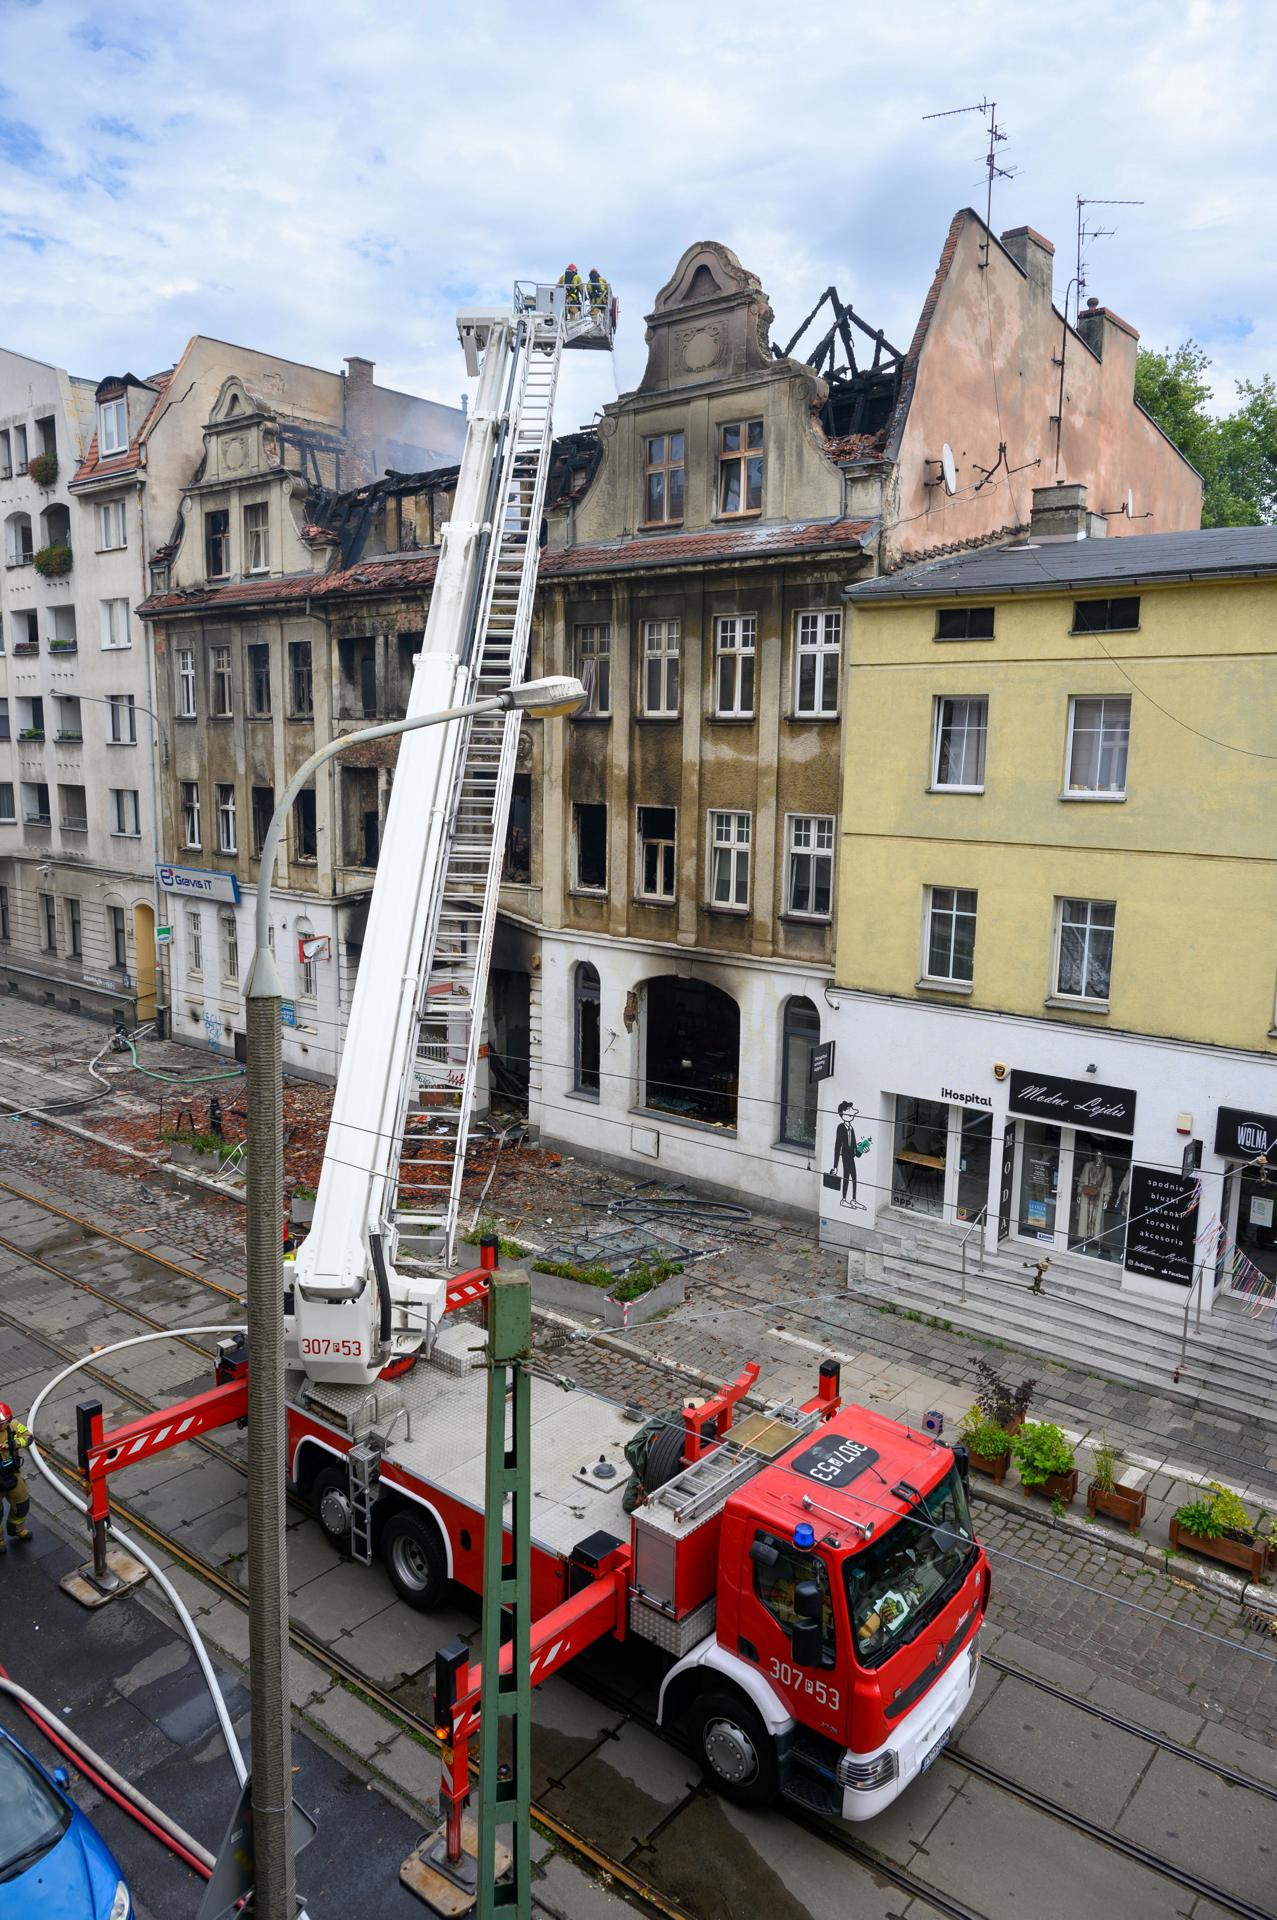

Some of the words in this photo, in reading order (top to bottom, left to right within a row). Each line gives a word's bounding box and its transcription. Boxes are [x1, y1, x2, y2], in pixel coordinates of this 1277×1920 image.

[941, 1087, 993, 1107] iHospital
[1017, 1084, 1070, 1108] Modne
[1074, 1097, 1127, 1118] Lejdis
[1237, 1125, 1268, 1150] WOLNA
[1147, 1179, 1185, 1193] spodnie
[1150, 1192, 1179, 1205] bluzki
[1144, 1205, 1183, 1219] sukienki
[1145, 1218, 1180, 1232] torebki
[1139, 1230, 1184, 1247] akcesoria
